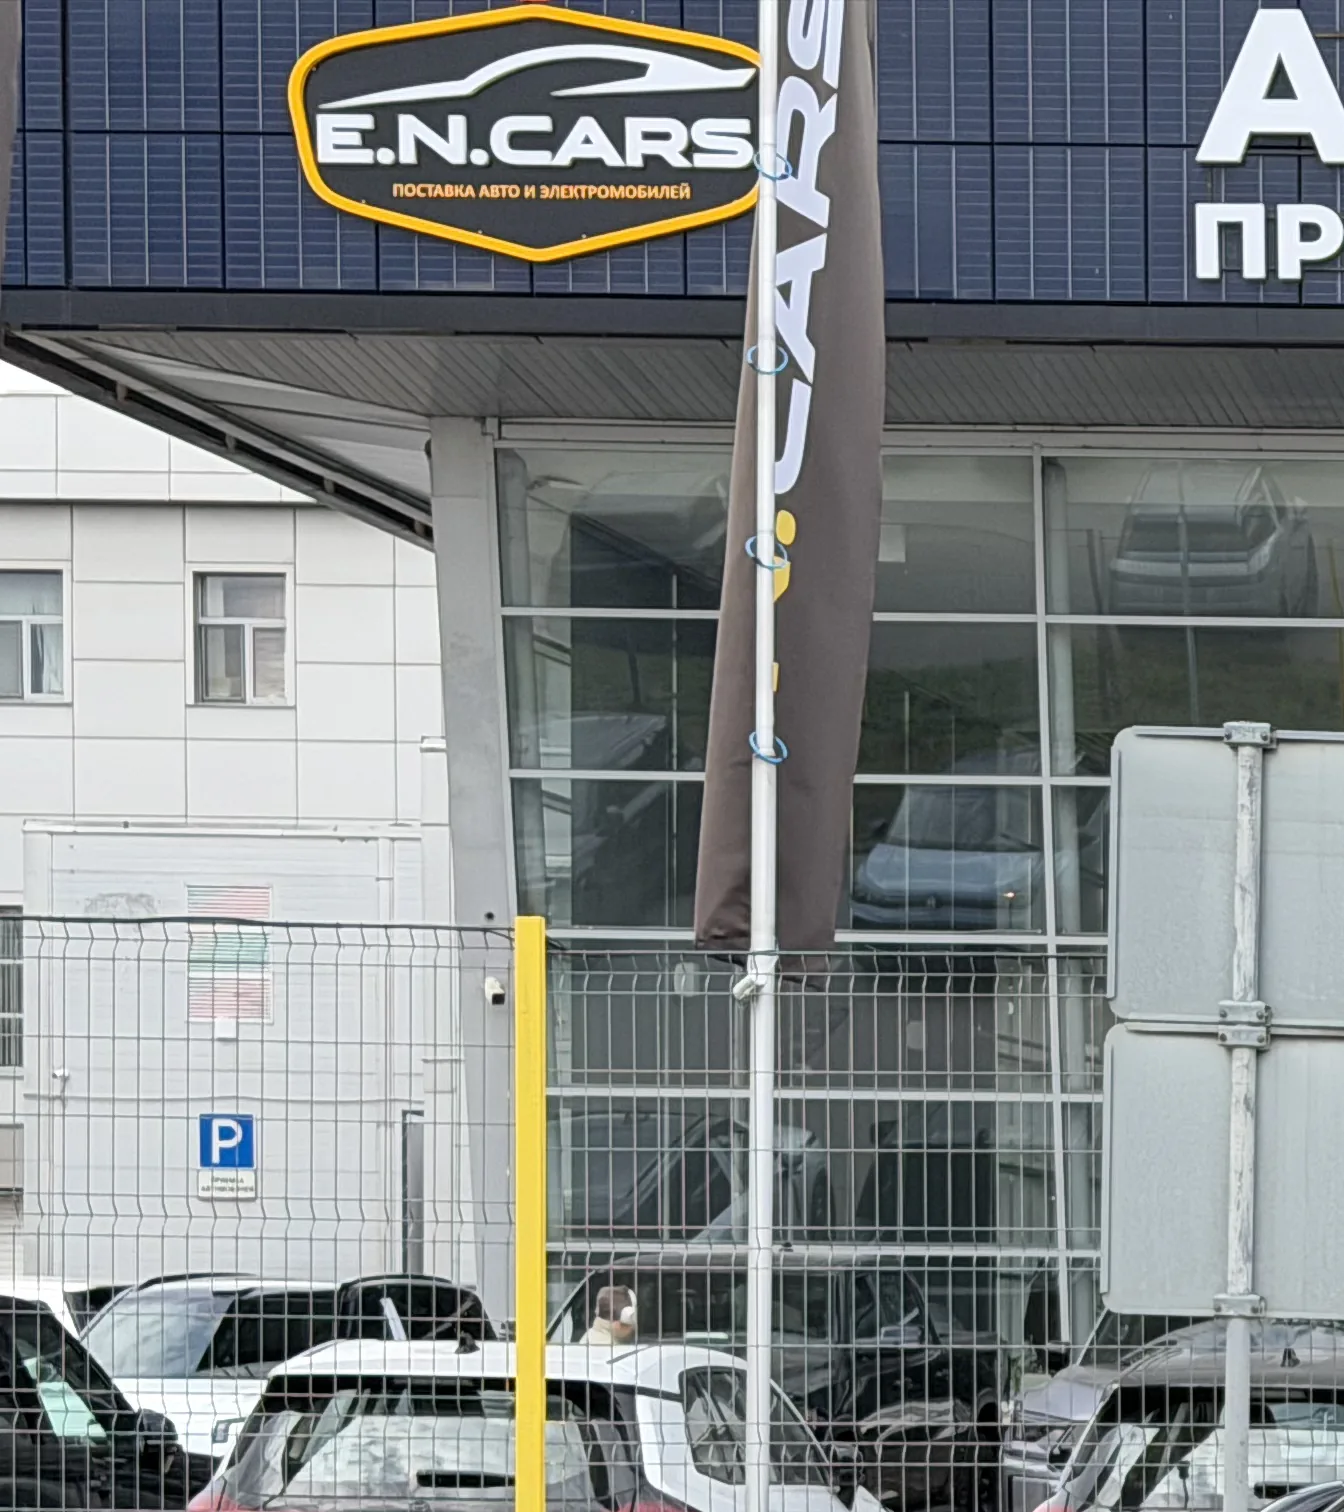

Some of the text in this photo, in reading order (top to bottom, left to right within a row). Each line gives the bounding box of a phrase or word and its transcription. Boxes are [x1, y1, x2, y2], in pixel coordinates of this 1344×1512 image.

[315, 112, 754, 170] E.N.CARS
[391, 182, 692, 202] ПОСТАВКА АВТО И ЭЛЕКТРОМОБИЛЕЙ
[211, 1118, 243, 1165] P
